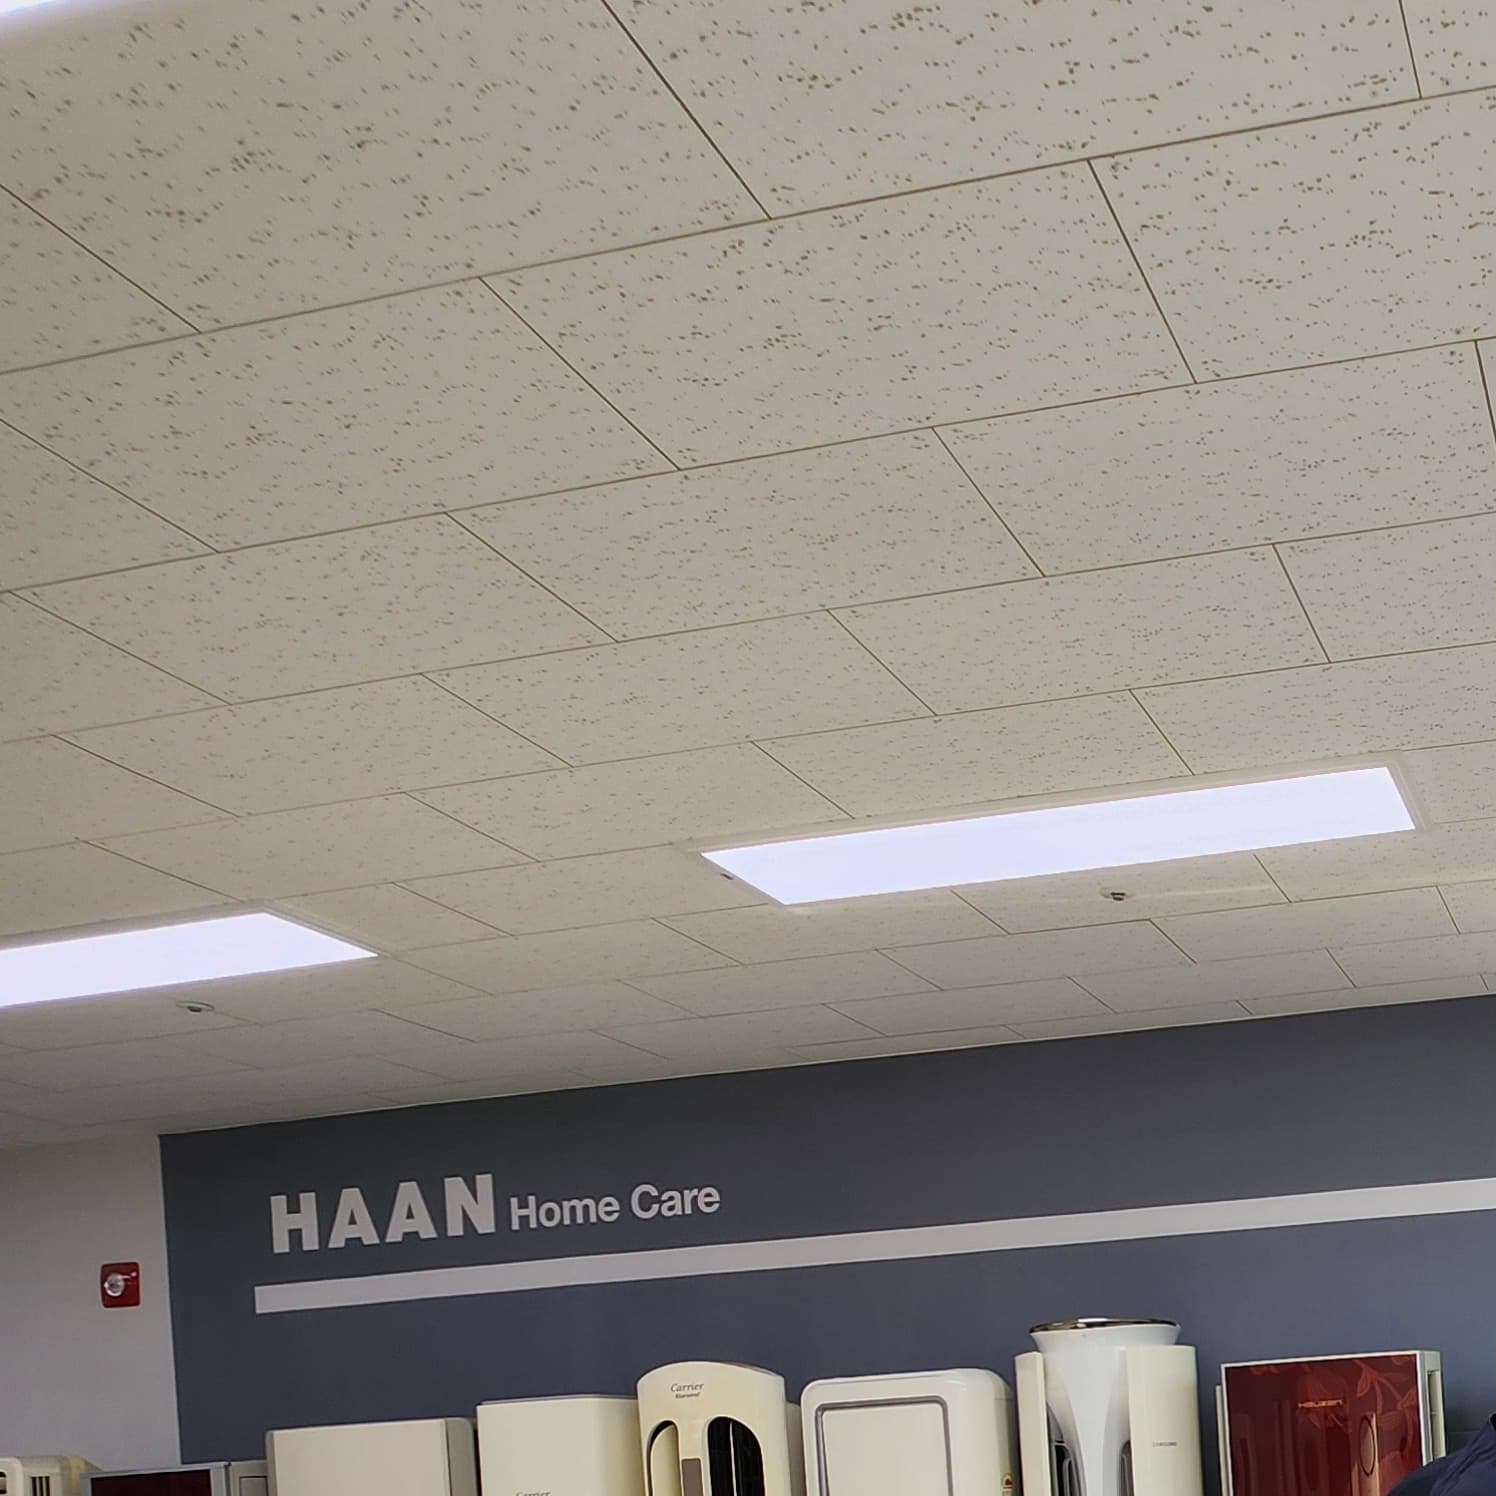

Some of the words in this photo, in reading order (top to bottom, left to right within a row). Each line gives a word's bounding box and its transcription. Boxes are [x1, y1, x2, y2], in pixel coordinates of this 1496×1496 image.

[270, 1173, 496, 1254] HAAN
[509, 1195, 621, 1231] Home
[631, 1184, 721, 1219] Care
